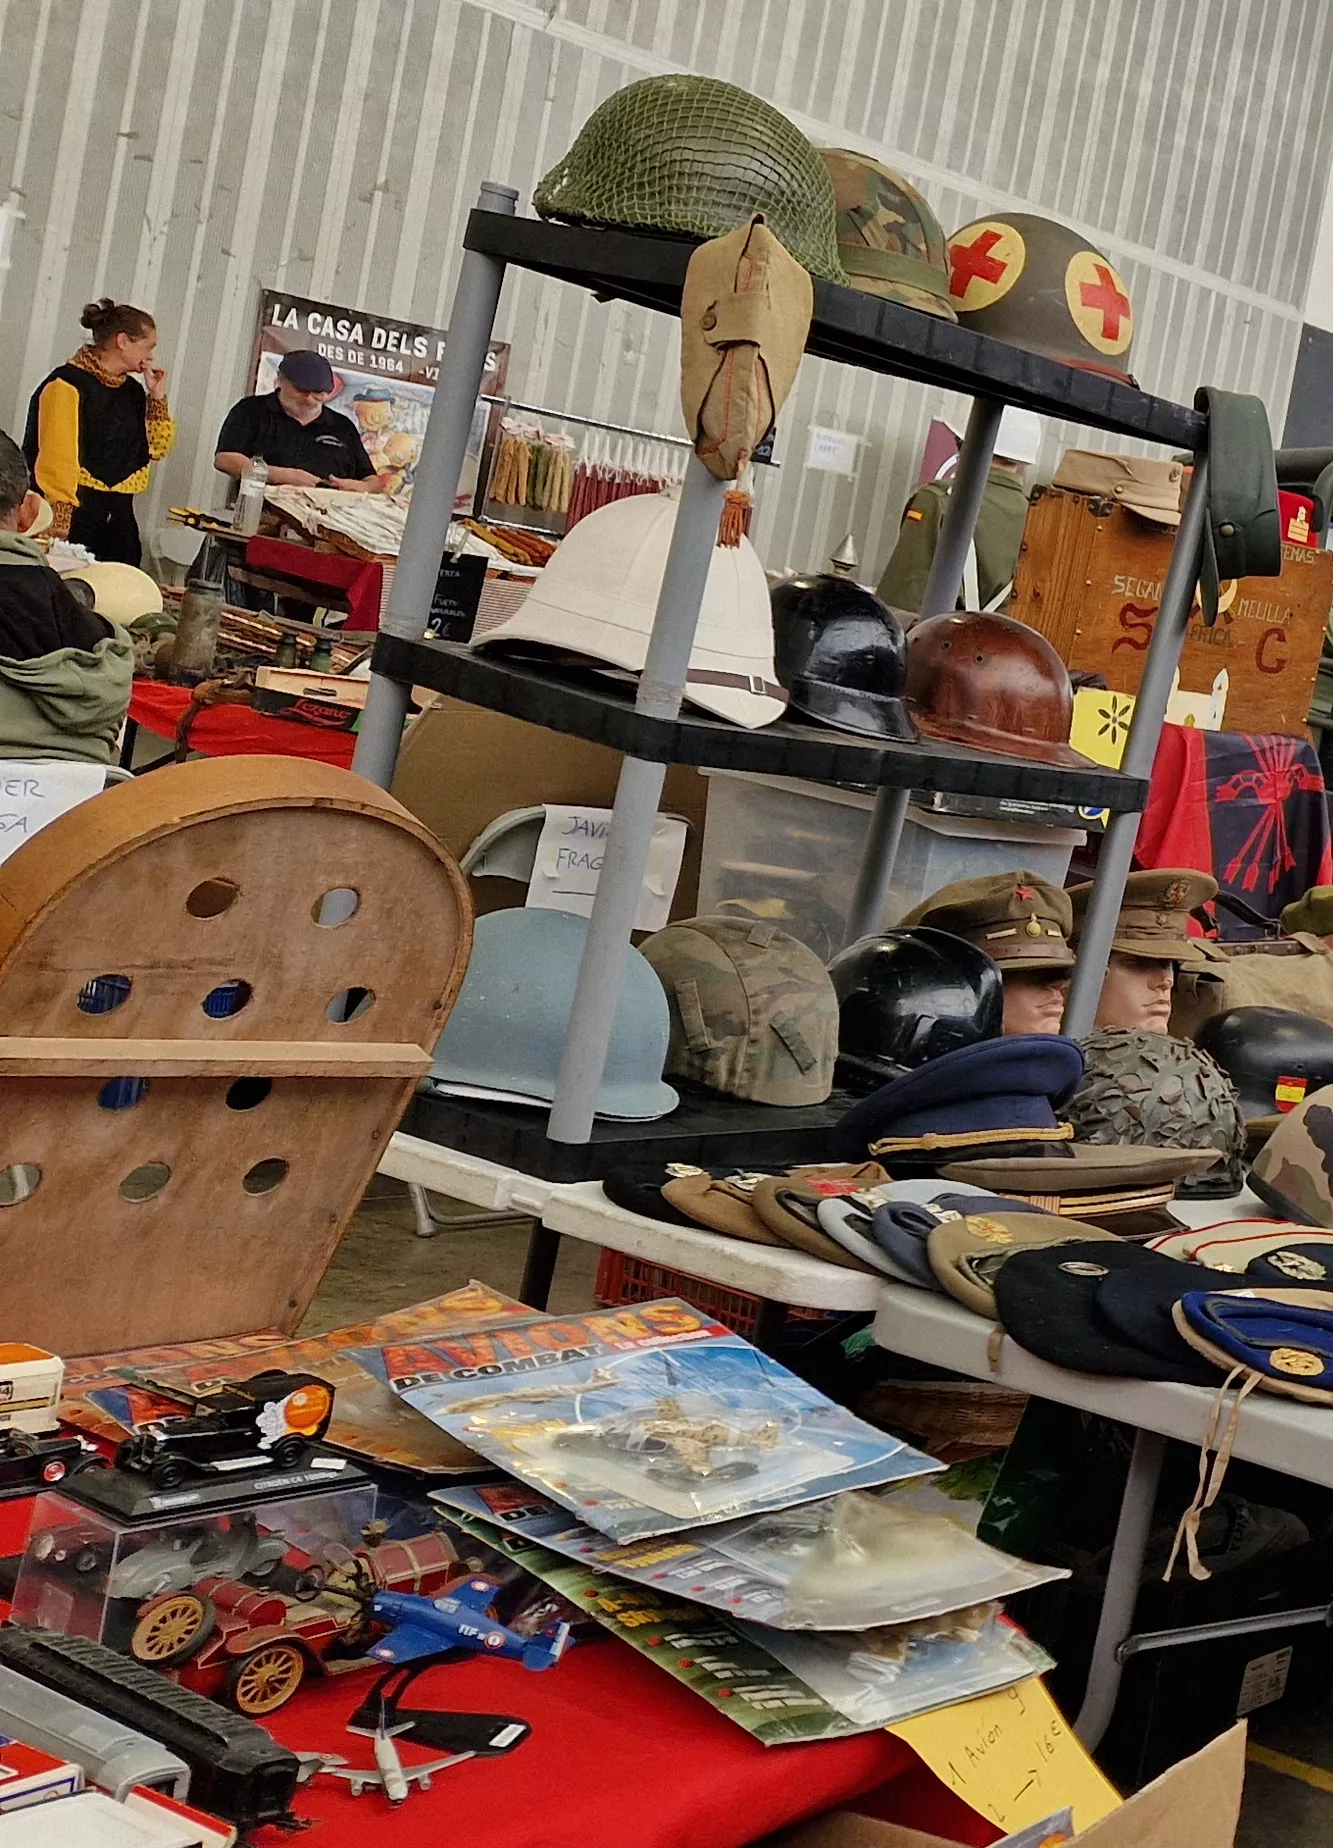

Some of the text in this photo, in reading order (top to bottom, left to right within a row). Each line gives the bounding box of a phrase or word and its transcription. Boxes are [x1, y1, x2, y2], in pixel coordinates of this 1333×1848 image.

[271, 303, 299, 331] LA
[307, 312, 364, 346] CASA
[371, 327, 428, 359] DELS
[318, 342, 344, 361] DES
[347, 351, 365, 367] DE
[370, 353, 404, 374] 1964
[1236, 598, 1293, 626] MELILLA
[1111, 602, 1288, 675] S C
[555, 847, 605, 871] FRAG
[382, 1303, 703, 1379] AVIONS
[392, 1343, 604, 1392] DE COMBAT
